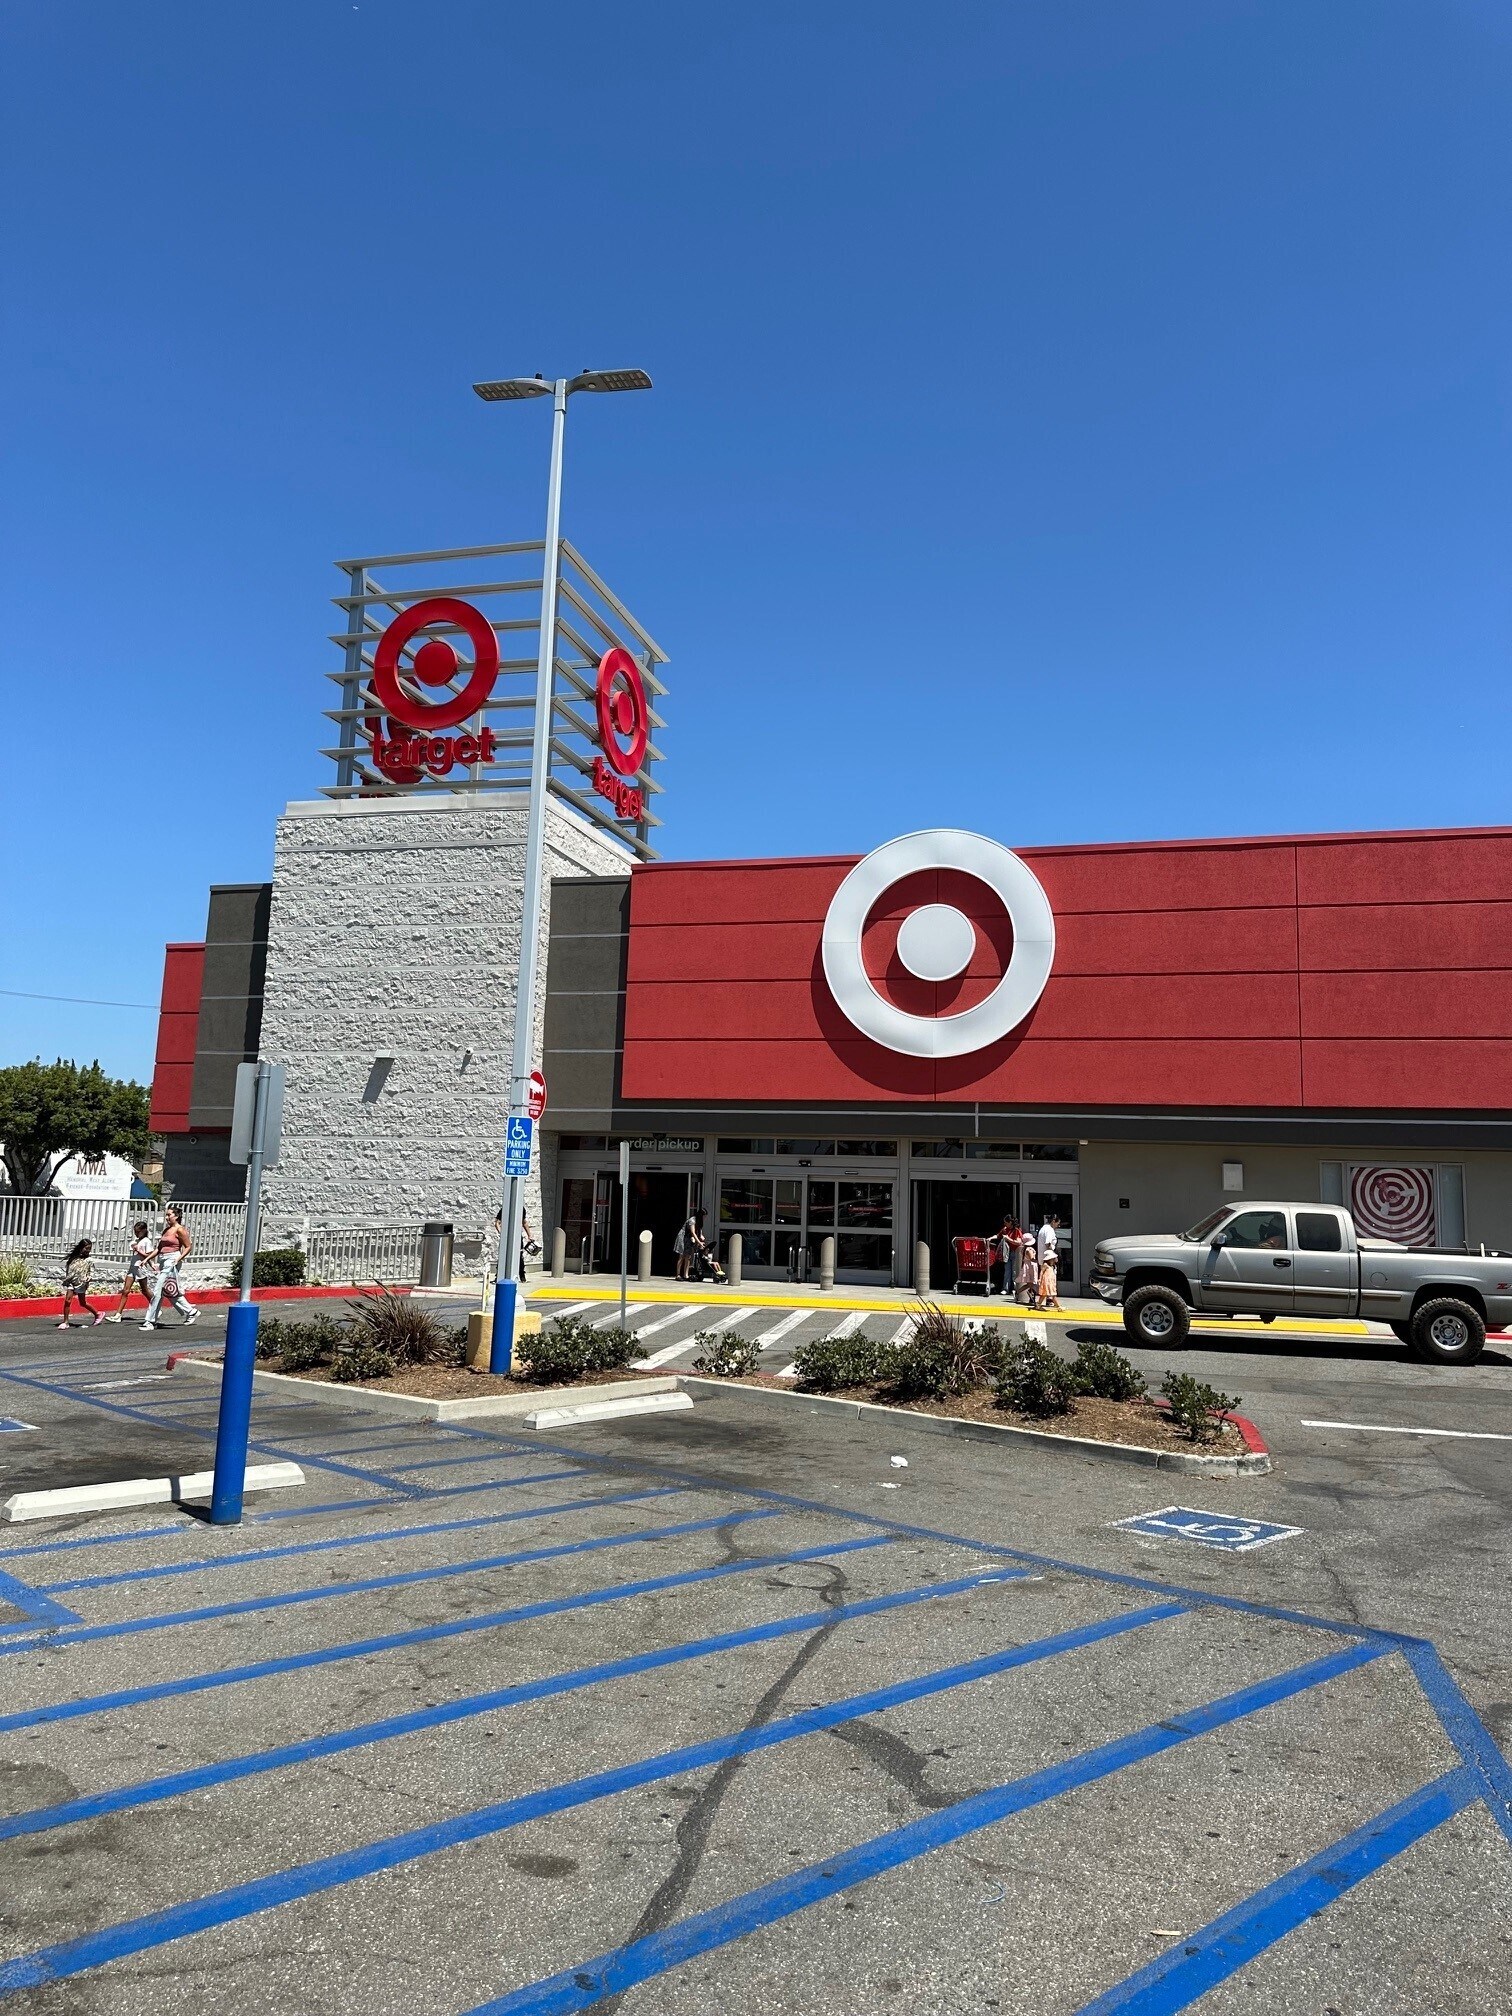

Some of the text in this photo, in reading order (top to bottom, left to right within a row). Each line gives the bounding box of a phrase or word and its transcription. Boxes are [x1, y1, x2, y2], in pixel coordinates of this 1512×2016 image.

[369, 726, 496, 776] target
[592, 756, 643, 822] target
[507, 1139, 531, 1150] PARKING
[628, 1138, 700, 1151] rder pickup
[511, 1149, 526, 1158] ONLY
[76, 1159, 107, 1176] MWA
